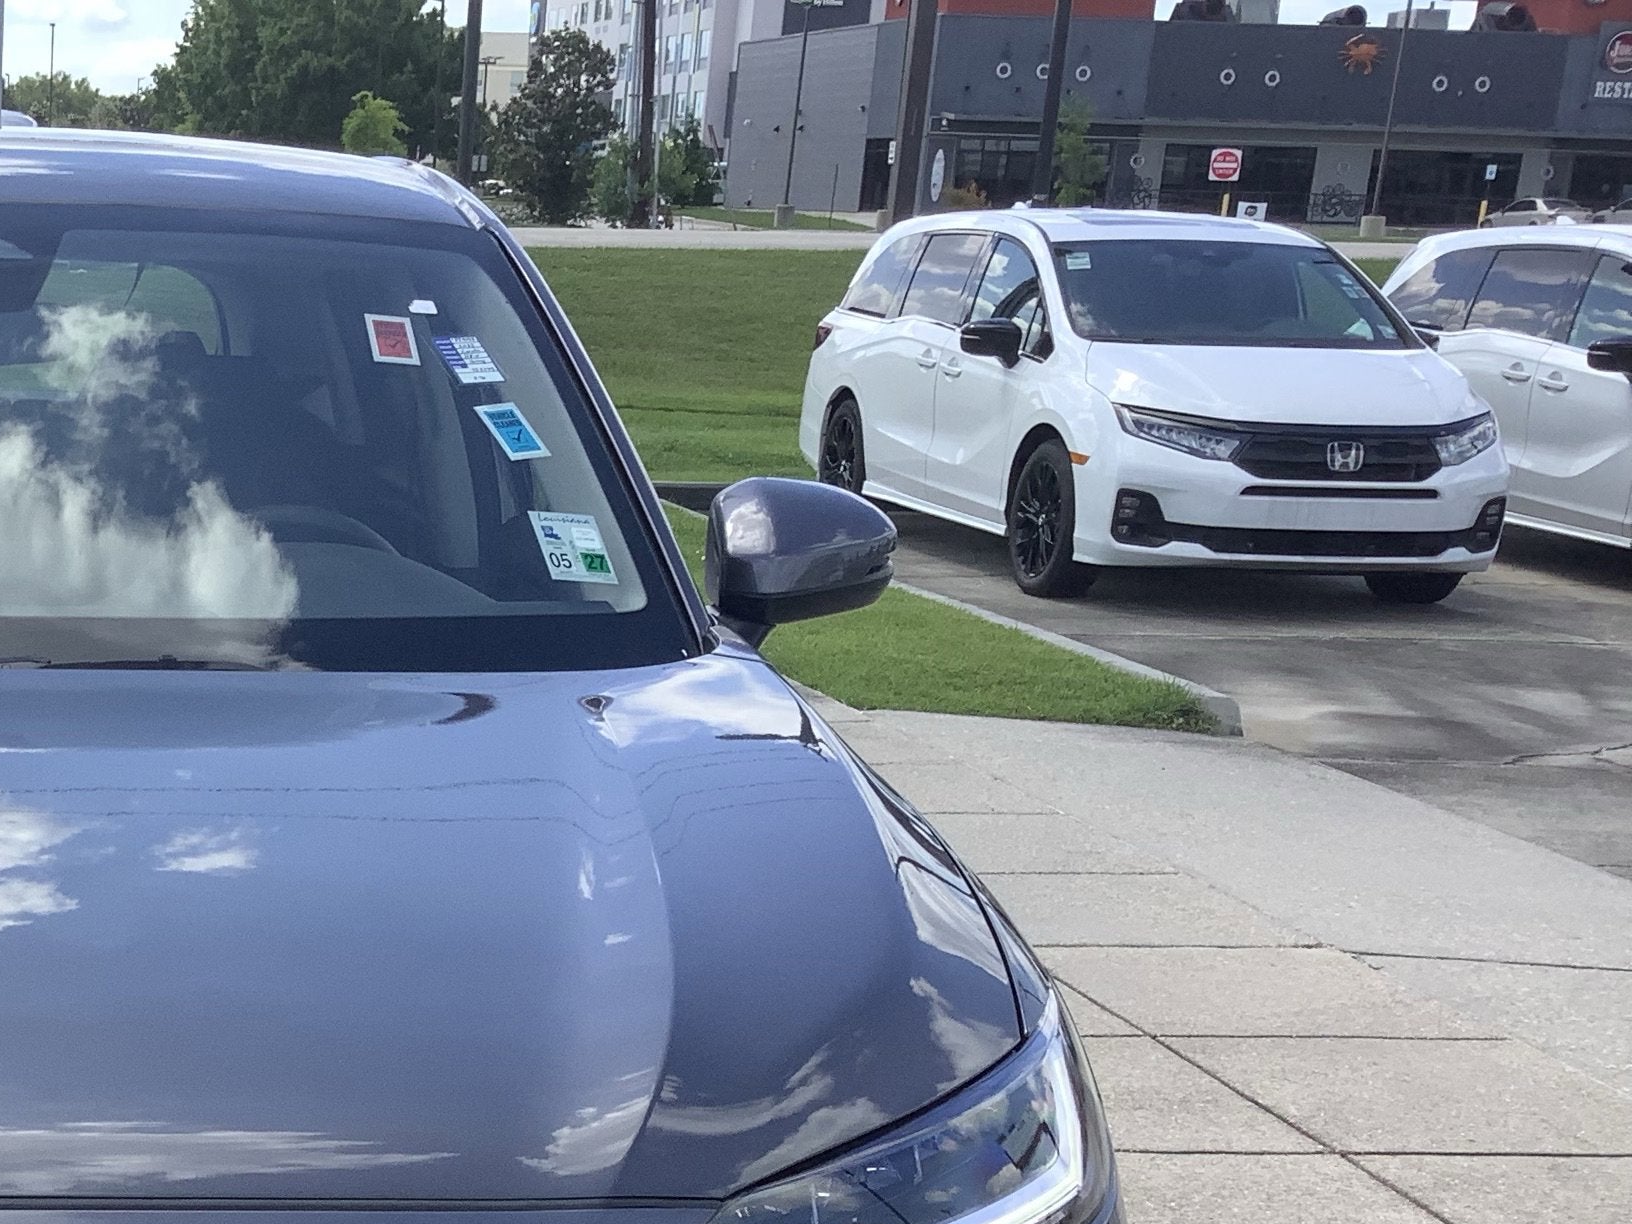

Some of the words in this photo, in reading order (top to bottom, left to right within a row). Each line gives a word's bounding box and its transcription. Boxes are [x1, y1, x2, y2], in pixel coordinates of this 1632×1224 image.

[1594, 81, 1632, 98] REST
[549, 552, 572, 569] 05
[584, 553, 606, 571] 27
